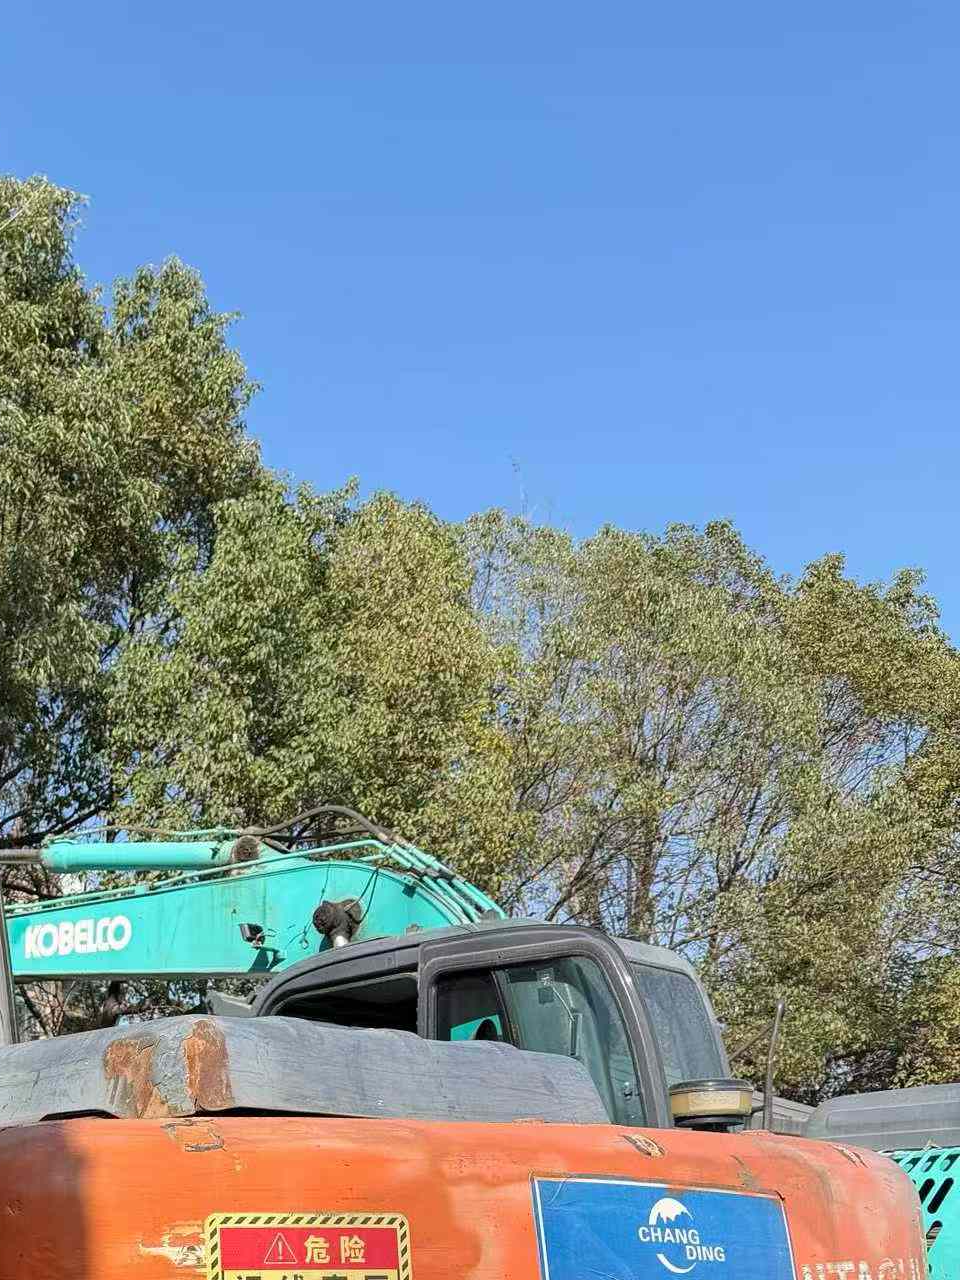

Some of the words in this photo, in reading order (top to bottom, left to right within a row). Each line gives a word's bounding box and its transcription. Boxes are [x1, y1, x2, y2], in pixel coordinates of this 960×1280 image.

[24, 915, 132, 959] KOBELCO
[638, 1226, 700, 1244] CHANG
[304, 1234, 366, 1264] 危险
[686, 1245, 726, 1262] DING
